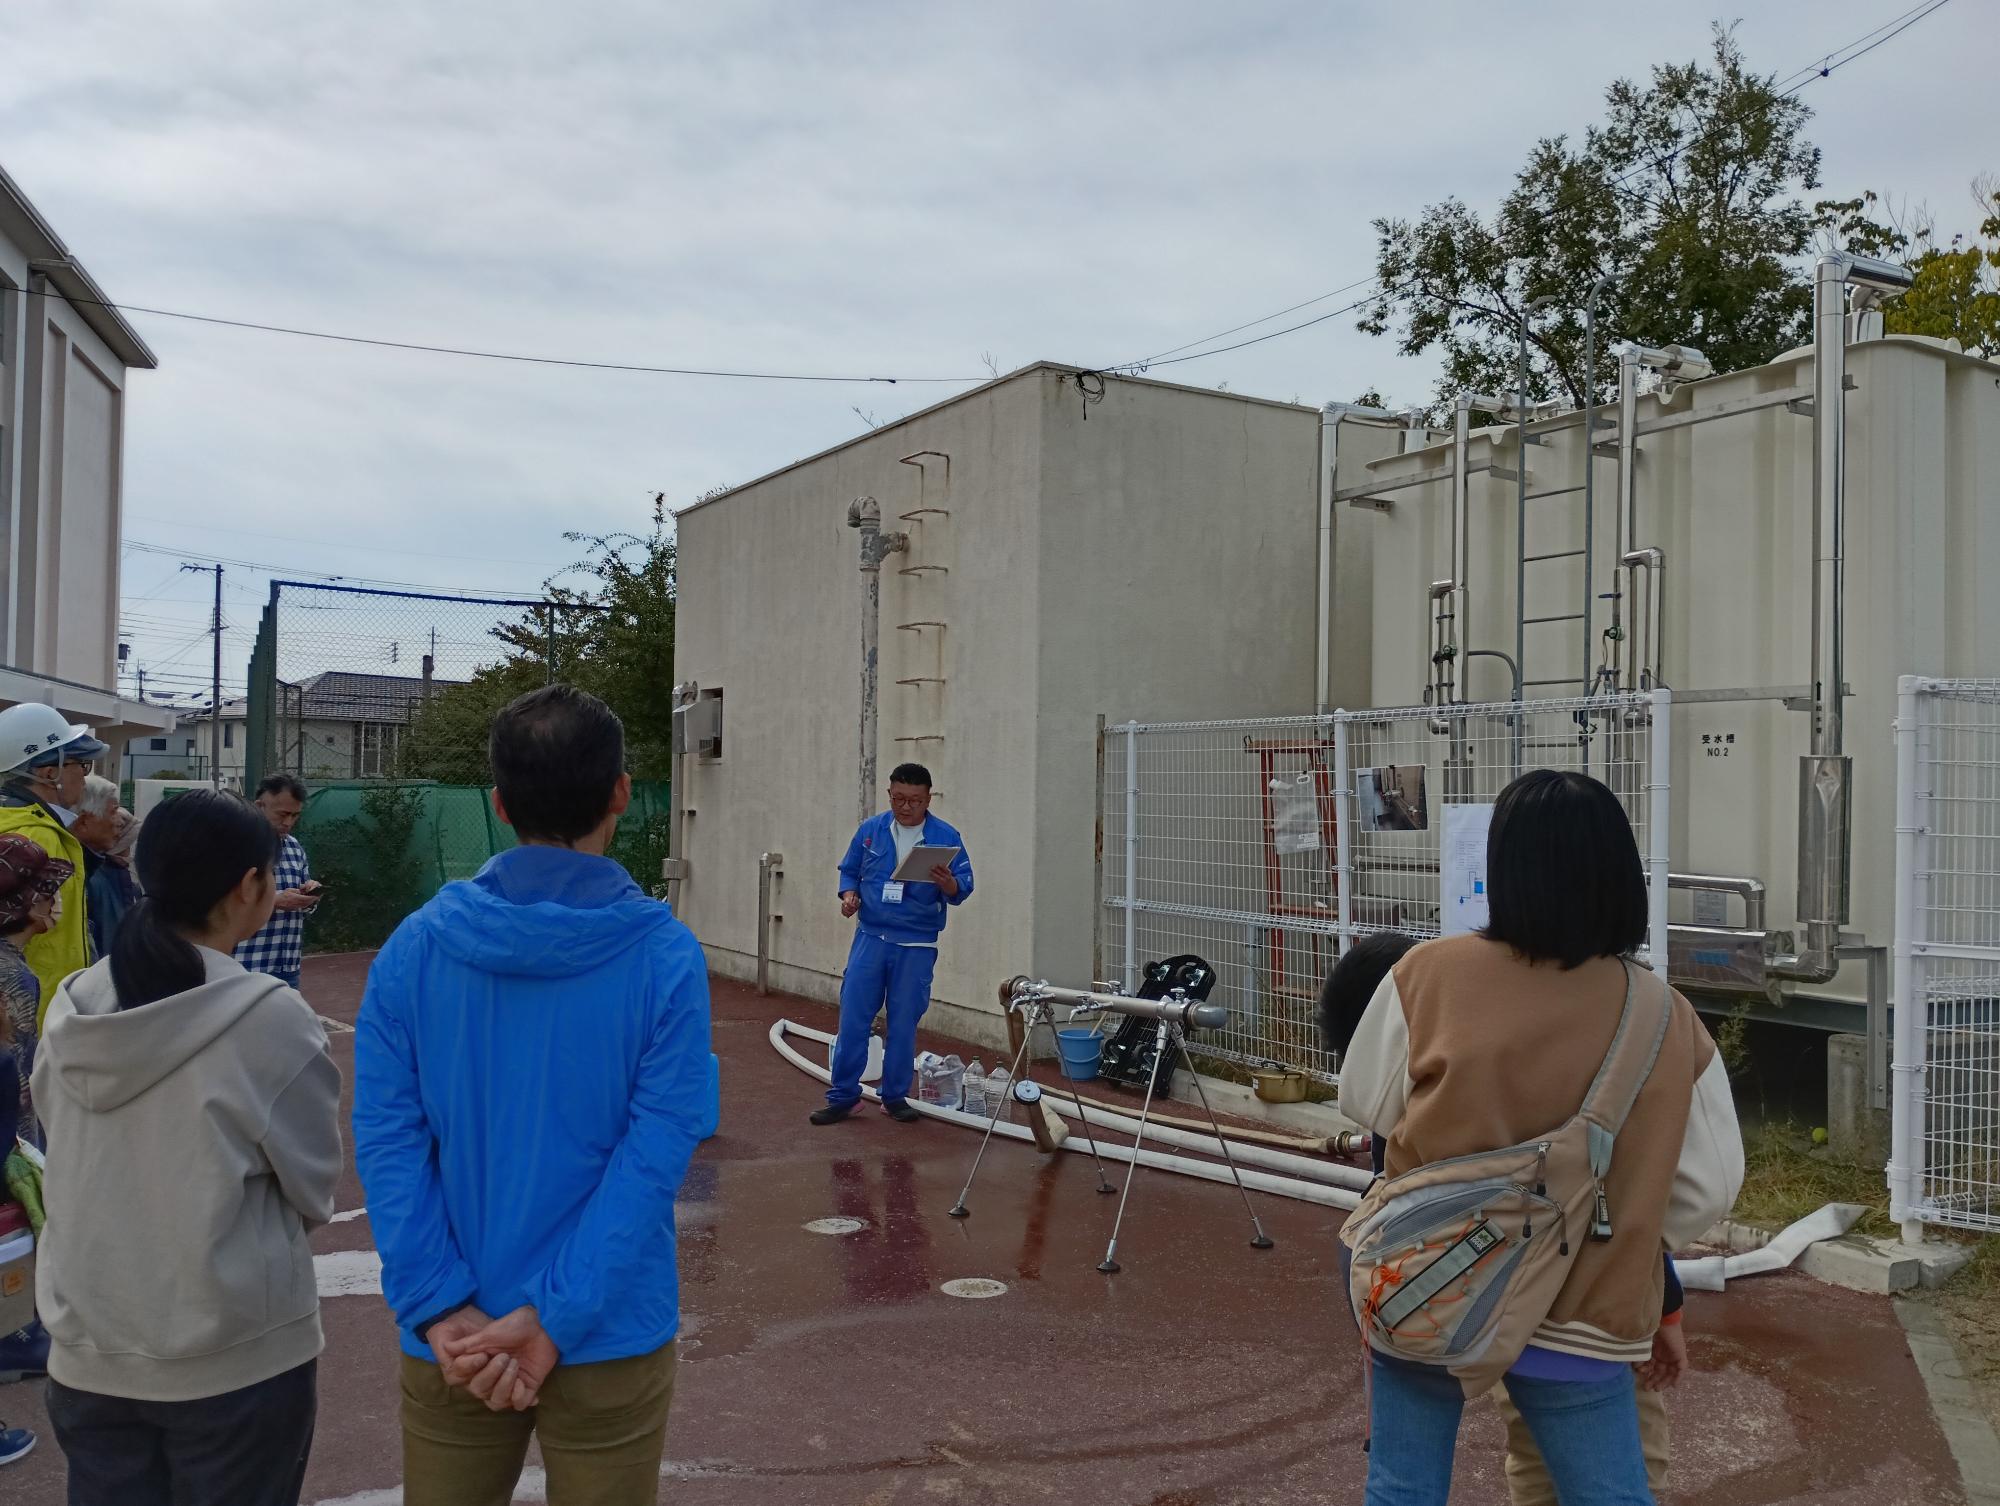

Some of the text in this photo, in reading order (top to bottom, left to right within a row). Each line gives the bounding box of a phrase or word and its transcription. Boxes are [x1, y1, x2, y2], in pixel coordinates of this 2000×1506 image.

[24, 733, 61, 755] 会長
[1701, 733, 1735, 745] 受水槽
